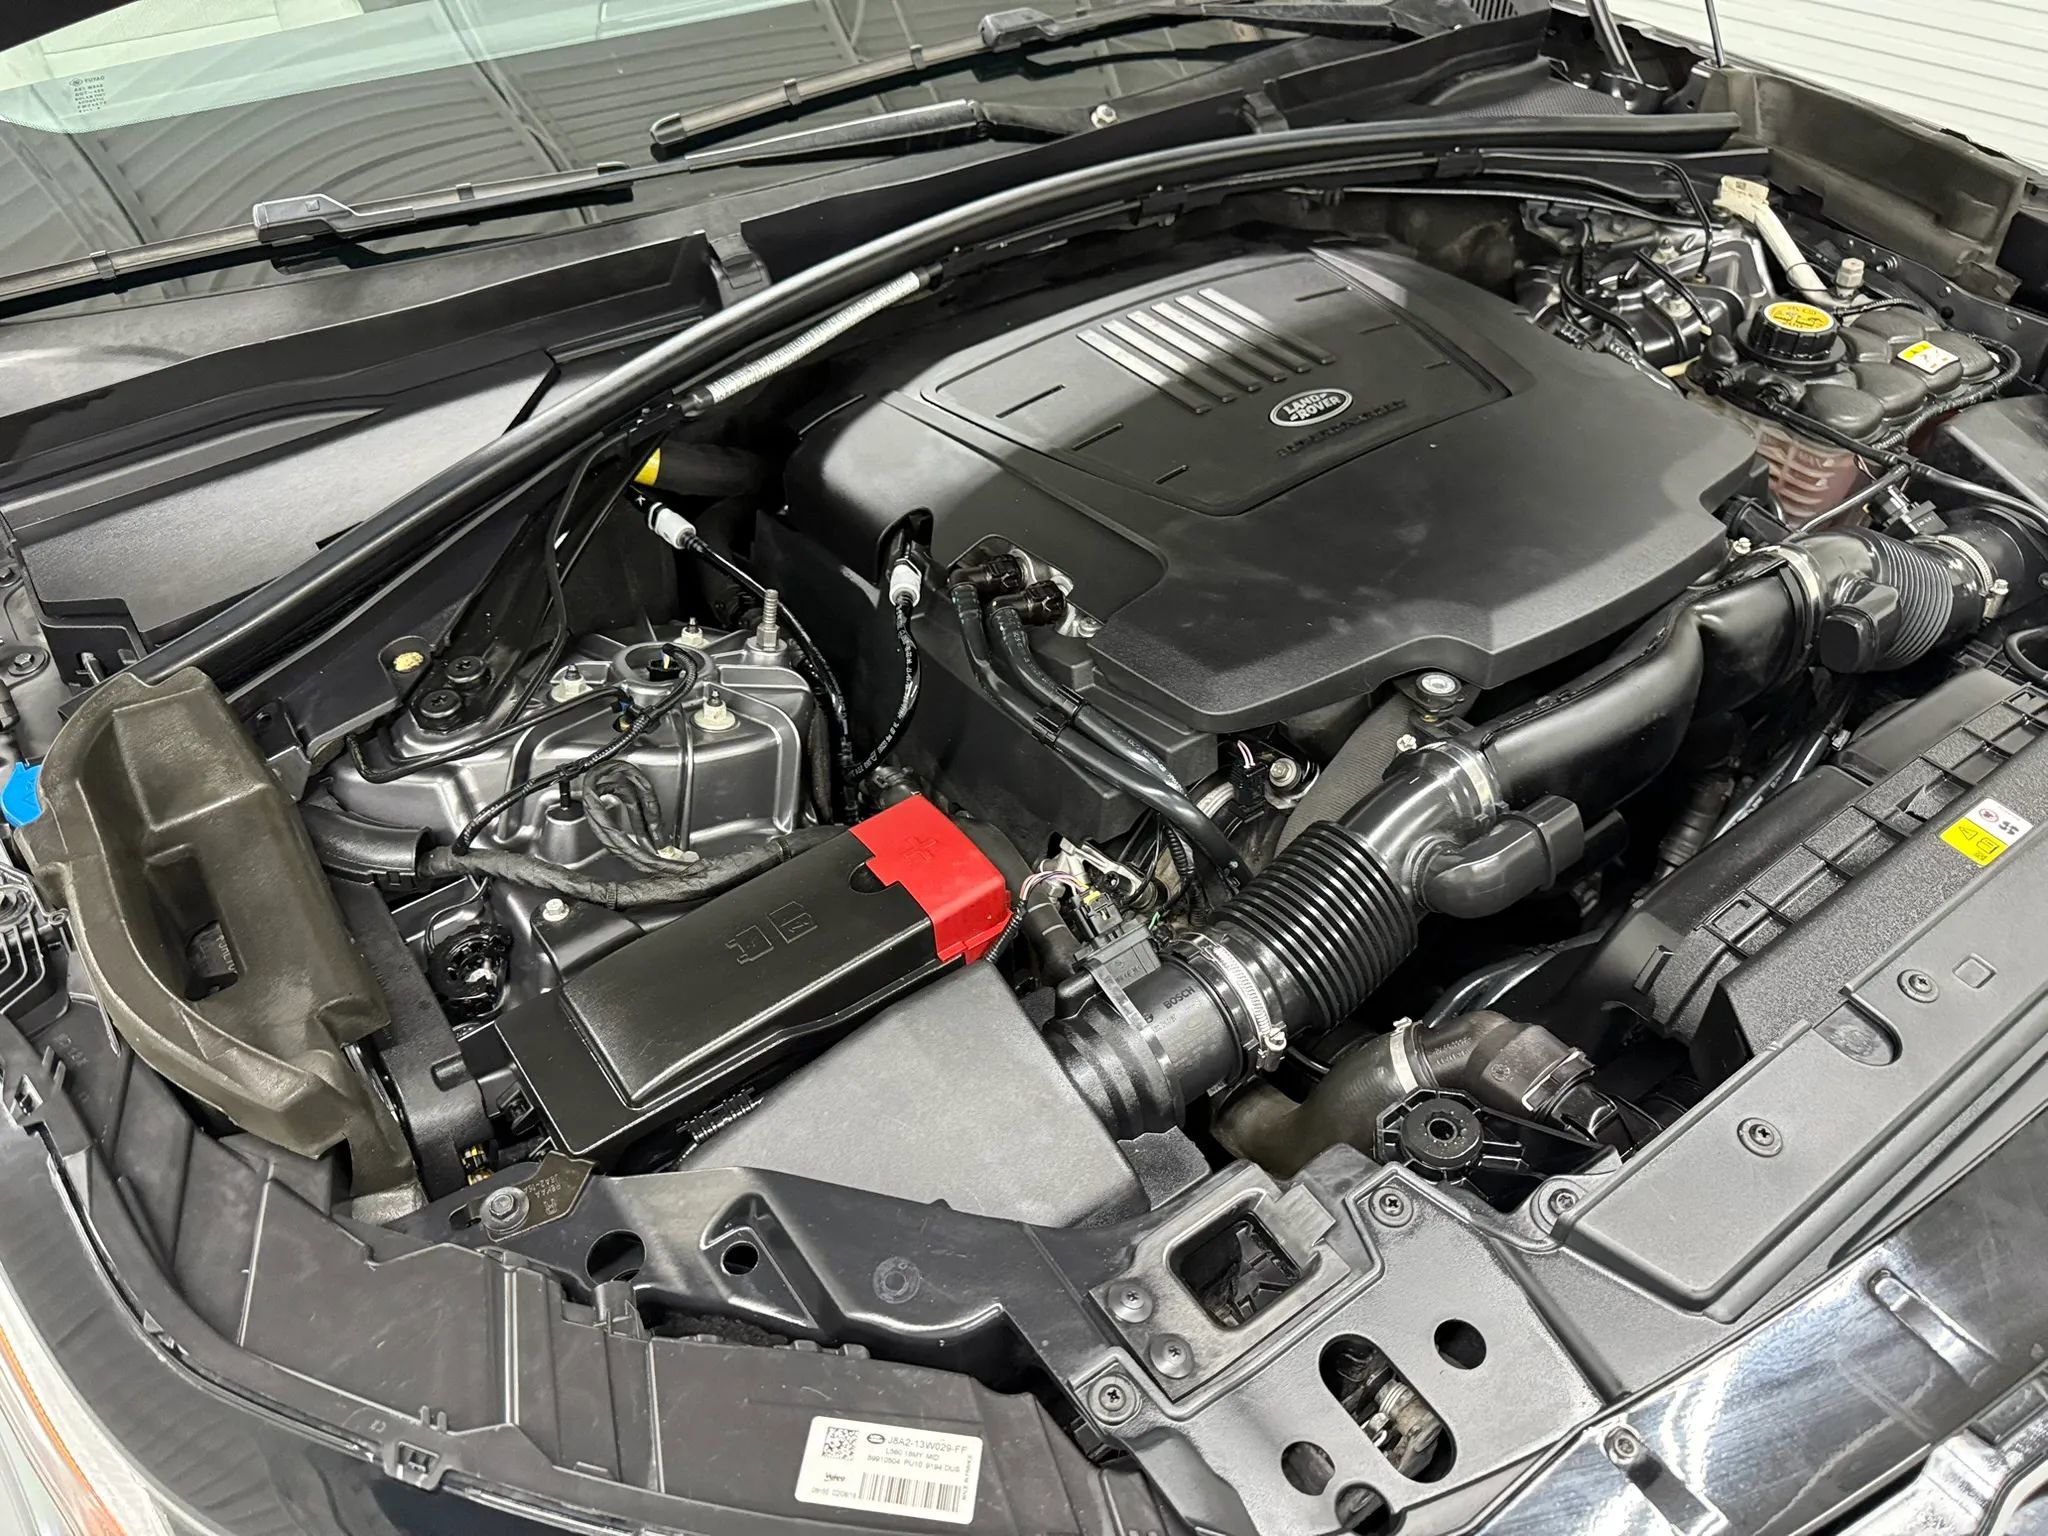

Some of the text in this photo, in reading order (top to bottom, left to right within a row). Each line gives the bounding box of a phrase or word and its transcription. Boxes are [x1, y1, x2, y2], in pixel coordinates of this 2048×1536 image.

[1283, 393, 1321, 415] LAND
[1299, 395, 1341, 420] ROVER
[1162, 985, 1195, 1009] BOSCH
